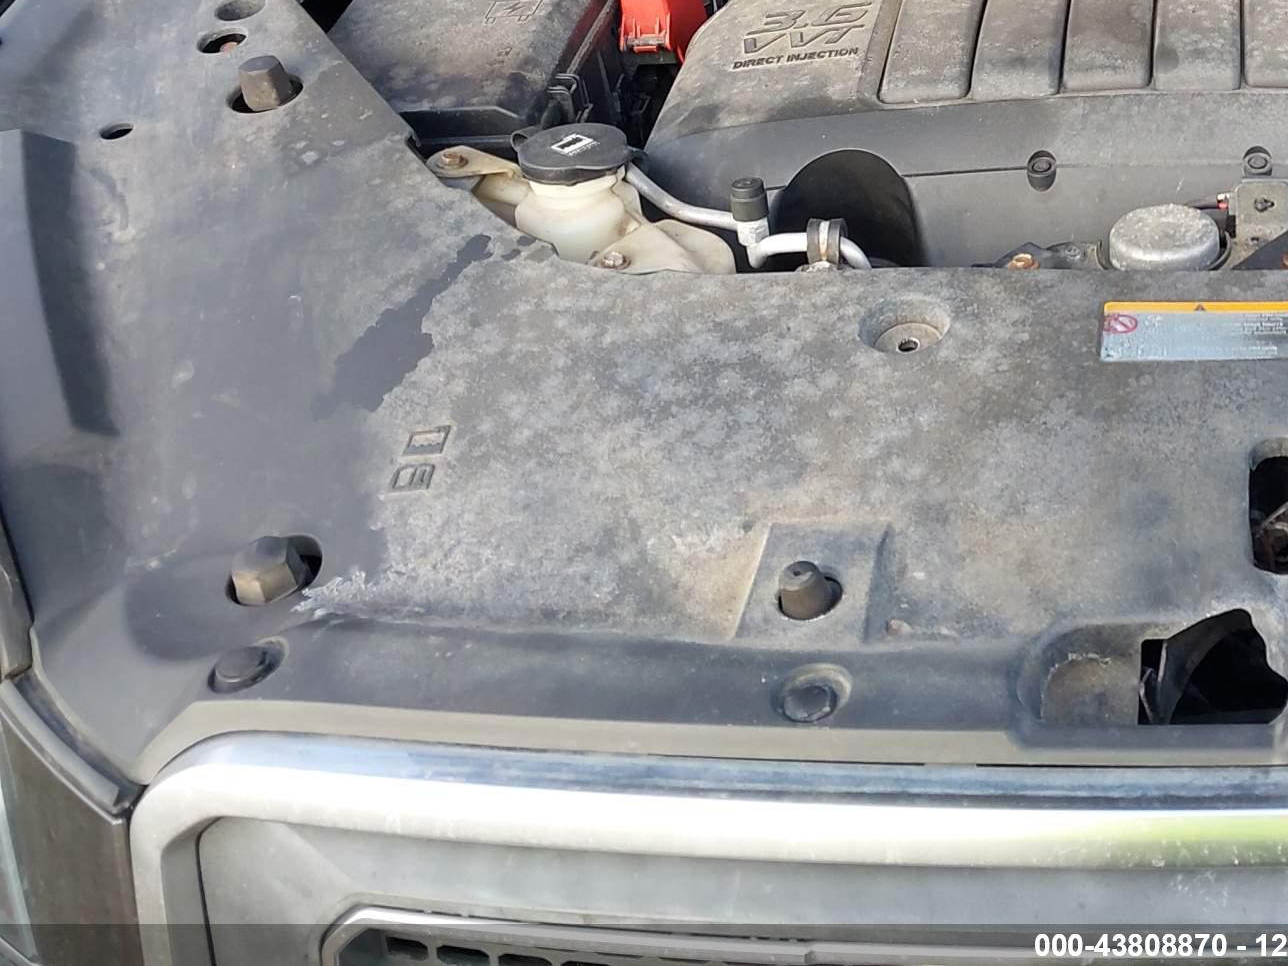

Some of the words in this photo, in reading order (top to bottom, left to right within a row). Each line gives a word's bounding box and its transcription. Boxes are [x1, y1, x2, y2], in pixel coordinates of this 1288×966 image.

[743, 24, 865, 54] VVT
[732, 54, 783, 70] DIRECT
[786, 46, 859, 64] INJECTION
